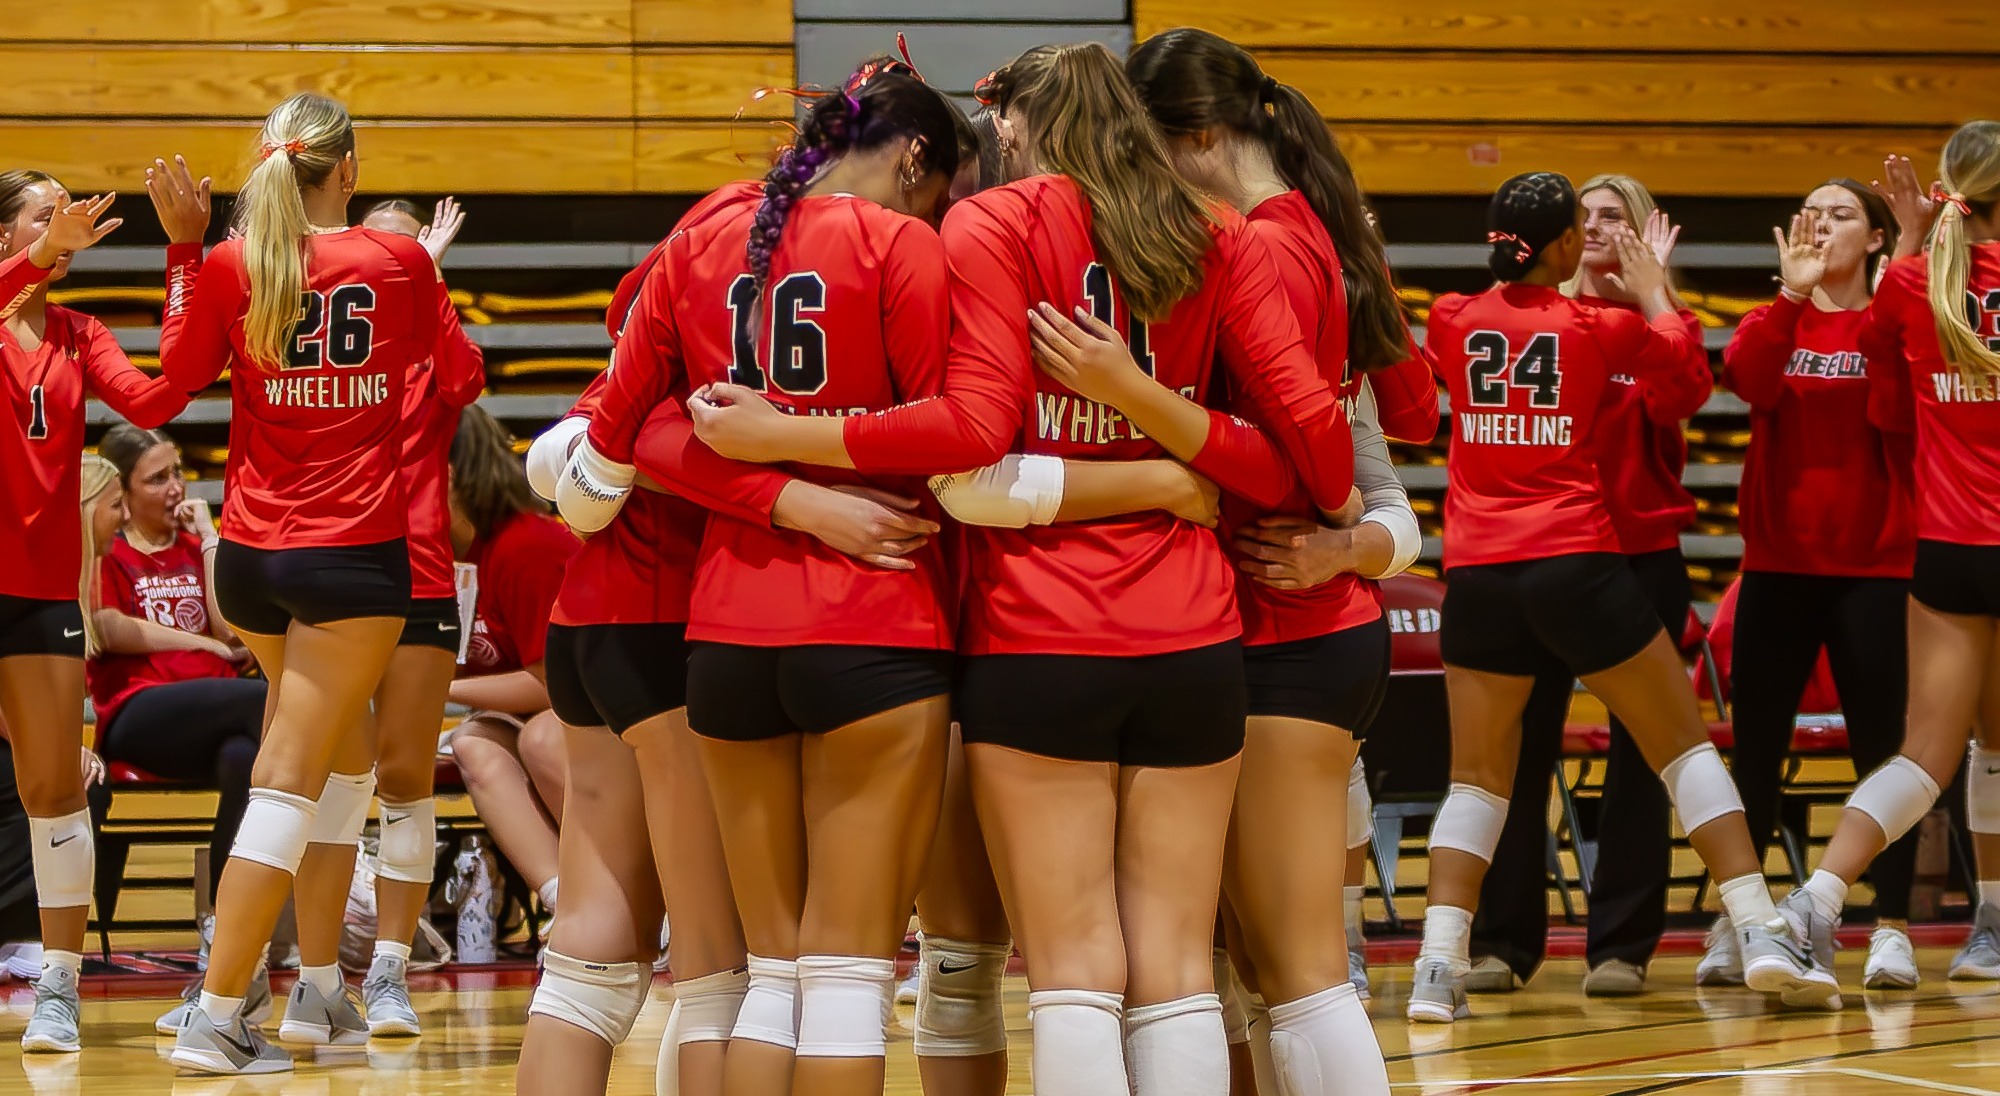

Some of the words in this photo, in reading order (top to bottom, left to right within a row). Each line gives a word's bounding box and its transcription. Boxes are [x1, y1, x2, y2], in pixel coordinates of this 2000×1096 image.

[280, 282, 376, 372] 26
[727, 271, 828, 396] 16
[263, 372, 389, 408] WHEELING
[1463, 329, 1563, 410] 24
[27, 384, 48, 440] 1
[1460, 412, 1574, 446] WHEELING
